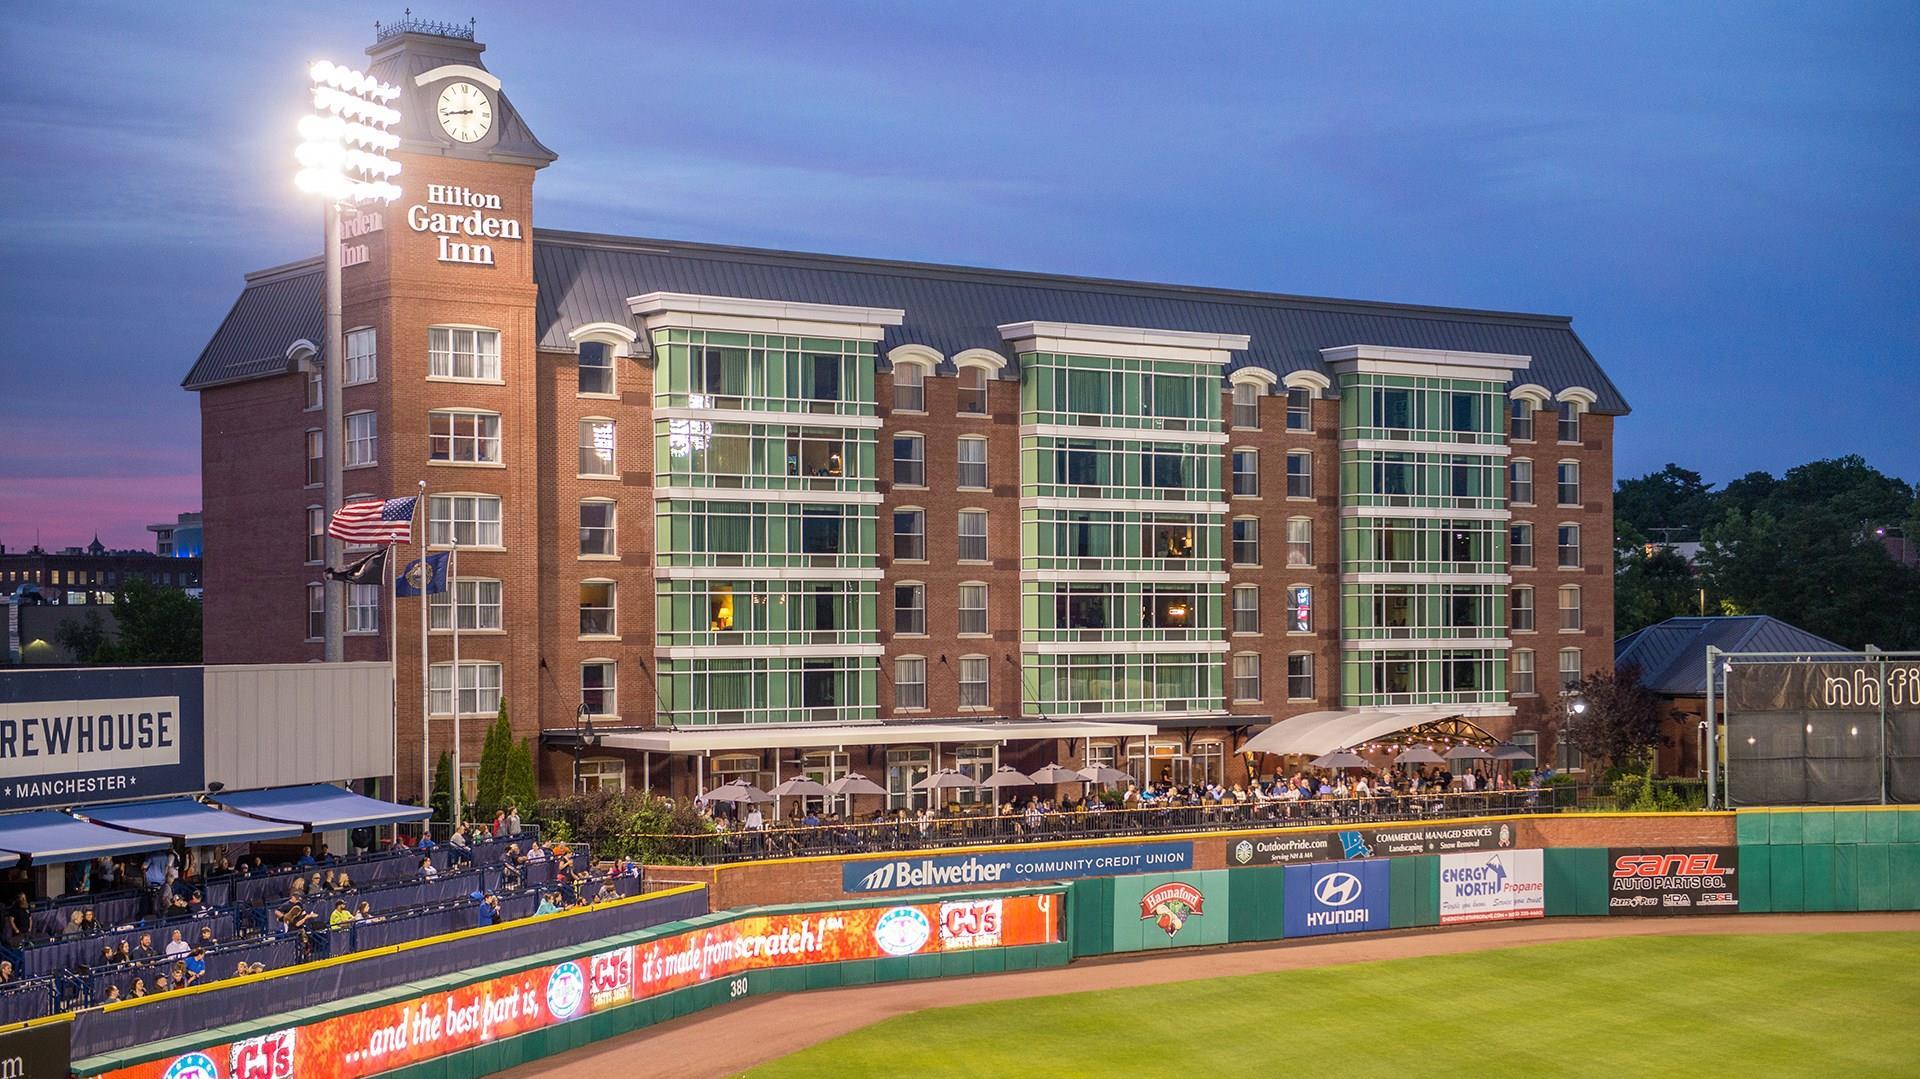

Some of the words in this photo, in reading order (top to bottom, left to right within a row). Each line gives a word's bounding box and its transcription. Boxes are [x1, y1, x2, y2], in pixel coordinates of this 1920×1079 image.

[427, 184, 502, 209] Hilton
[408, 205, 522, 239] Garden
[437, 235, 494, 265] Inn
[1825, 669, 1880, 705] nh
[0, 712, 172, 758] REWHOUSE
[16, 775, 126, 798] MANCHESTER
[1256, 839, 1328, 852] OutdoorPride.com
[1376, 832, 1424, 843] COMMERCIAL
[1425, 829, 1461, 840] MANAGED
[1462, 828, 1493, 838] SERVICES
[1388, 843, 1424, 853] Landscaping
[1440, 841, 1456, 849] Snow
[1456, 839, 1480, 849] Removal
[1271, 852, 1289, 861] Serving
[896, 857, 1006, 888] Bellwether
[1015, 858, 1093, 874] COMMUNITY
[1095, 855, 1141, 869] CREDIT
[1146, 852, 1185, 864] UNION
[1442, 866, 1489, 883] ENERGY
[1455, 881, 1496, 897] NORTH
[1503, 882, 1543, 894] Propane
[1613, 877, 1652, 891] AUTO
[1653, 876, 1700, 890] PARTS
[1702, 875, 1726, 889] CO.
[1146, 887, 1199, 909] Hannaford
[946, 905, 997, 937] CJ's
[1307, 908, 1369, 927] HYUNDAI
[642, 942, 663, 984] it's
[665, 938, 700, 977] made
[700, 933, 733, 980] from
[734, 918, 827, 959] scratch!
[595, 951, 629, 991] CJ's
[730, 977, 748, 998] 380
[412, 1001, 441, 1046] the
[446, 995, 481, 1037] best
[480, 993, 519, 1041] part
[522, 984, 539, 1019] is,
[237, 1034, 290, 1079] CJ's
